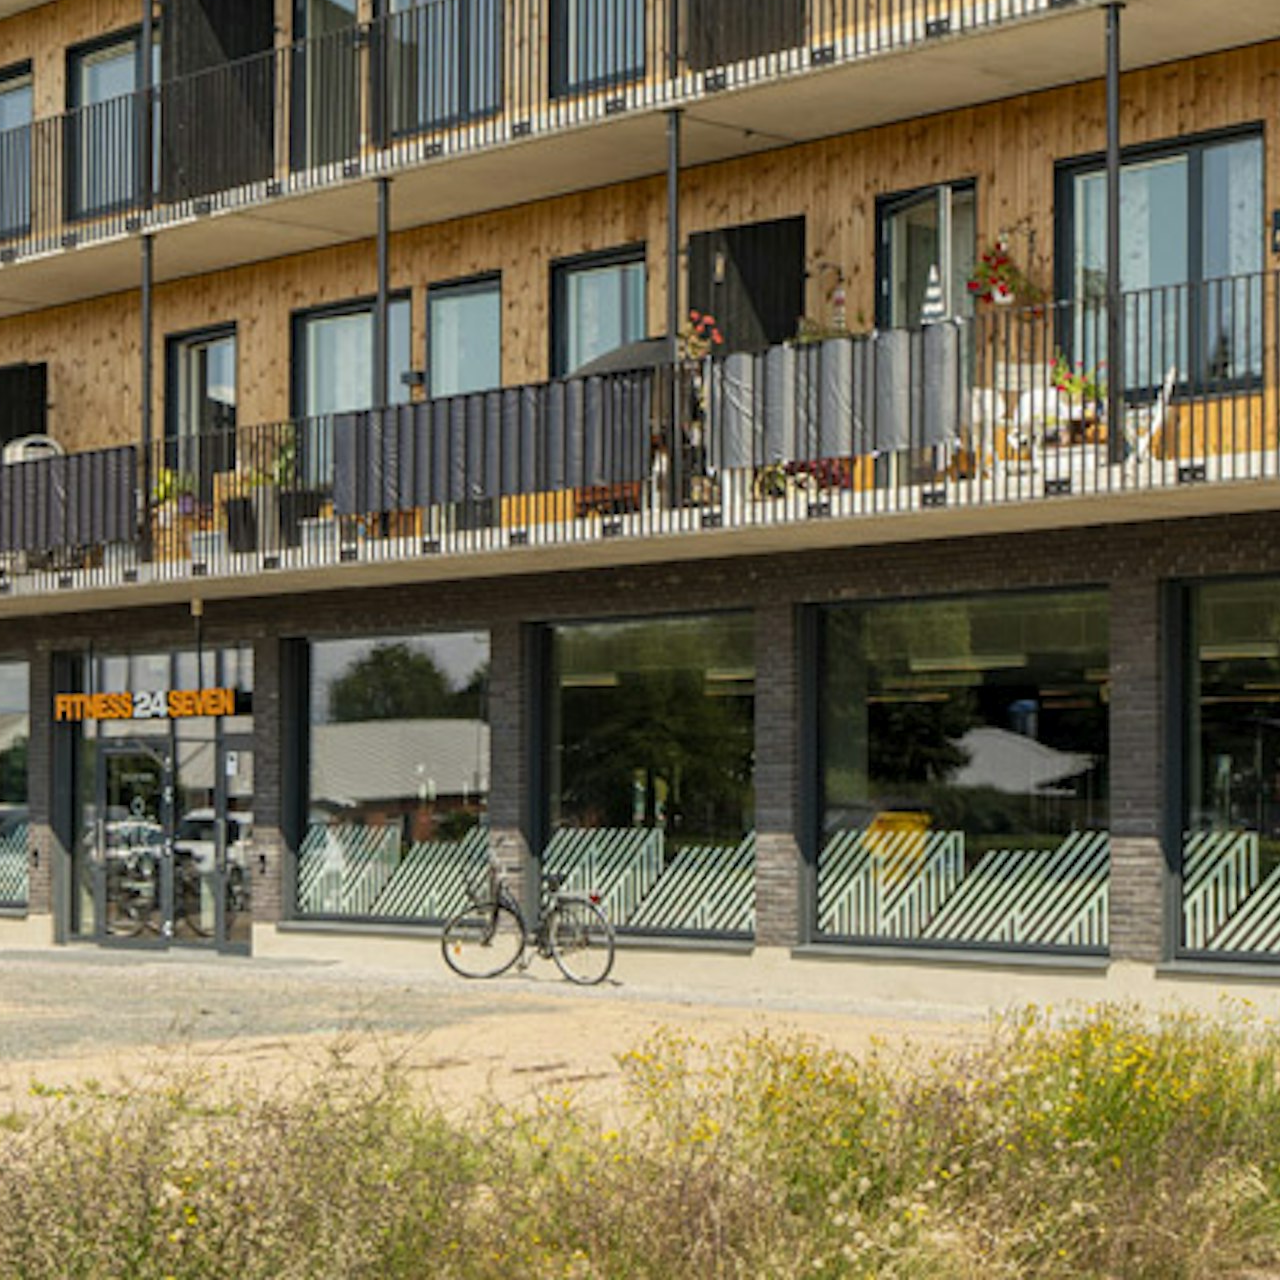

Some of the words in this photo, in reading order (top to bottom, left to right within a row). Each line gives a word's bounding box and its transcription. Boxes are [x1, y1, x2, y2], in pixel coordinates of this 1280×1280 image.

[55, 693, 133, 720] FITNESS
[133, 690, 168, 718] 24
[168, 687, 235, 718] SEVEN
